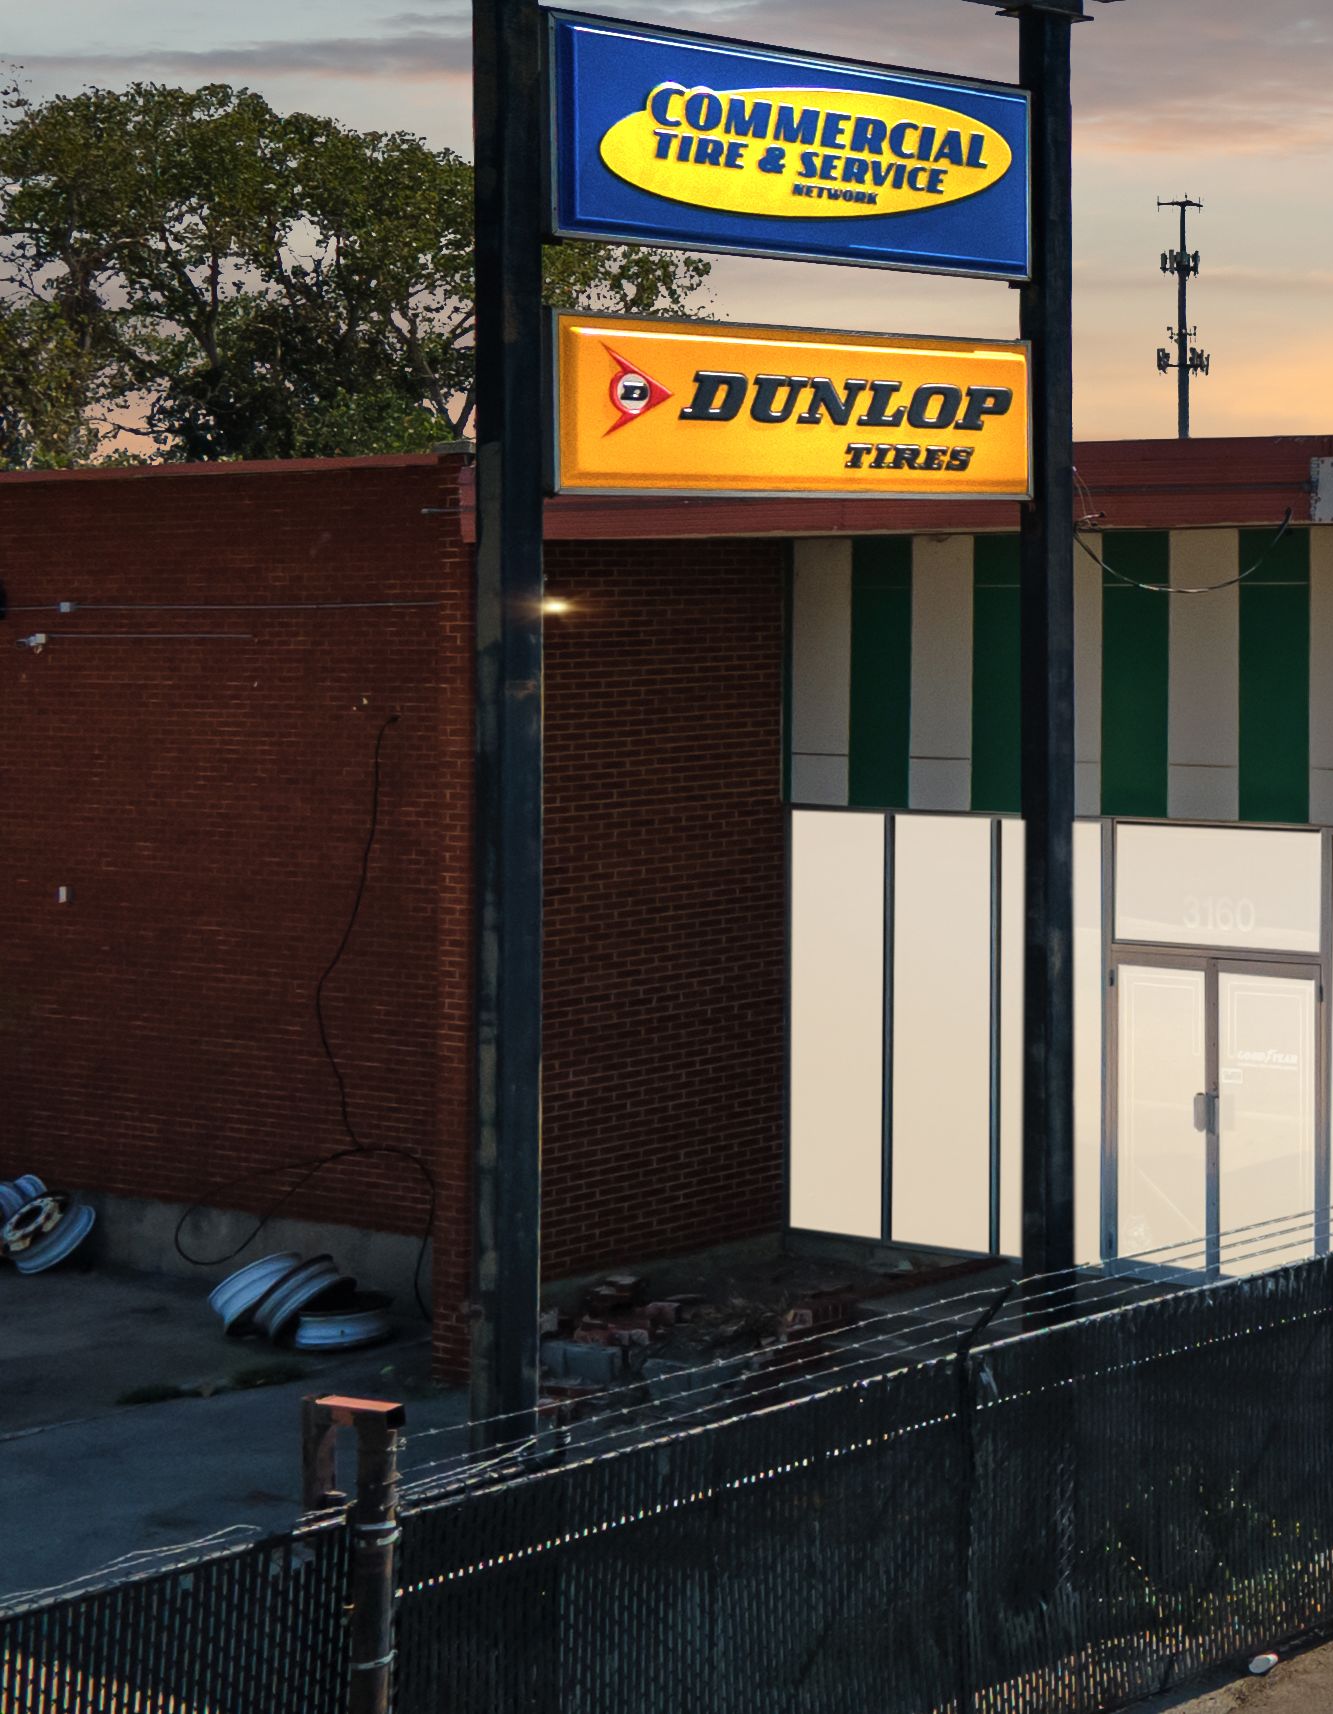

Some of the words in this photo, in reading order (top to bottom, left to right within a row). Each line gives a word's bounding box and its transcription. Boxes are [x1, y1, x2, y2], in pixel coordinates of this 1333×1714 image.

[650, 87, 988, 169] COMMERCIAL
[653, 129, 749, 169] TIRE
[757, 145, 787, 174] &
[797, 149, 948, 194] SERVICE
[791, 183, 879, 205] NETWORK
[678, 370, 1013, 430] DUNLOP
[845, 443, 974, 471] TIRES
[1182, 894, 1256, 933] 3160
